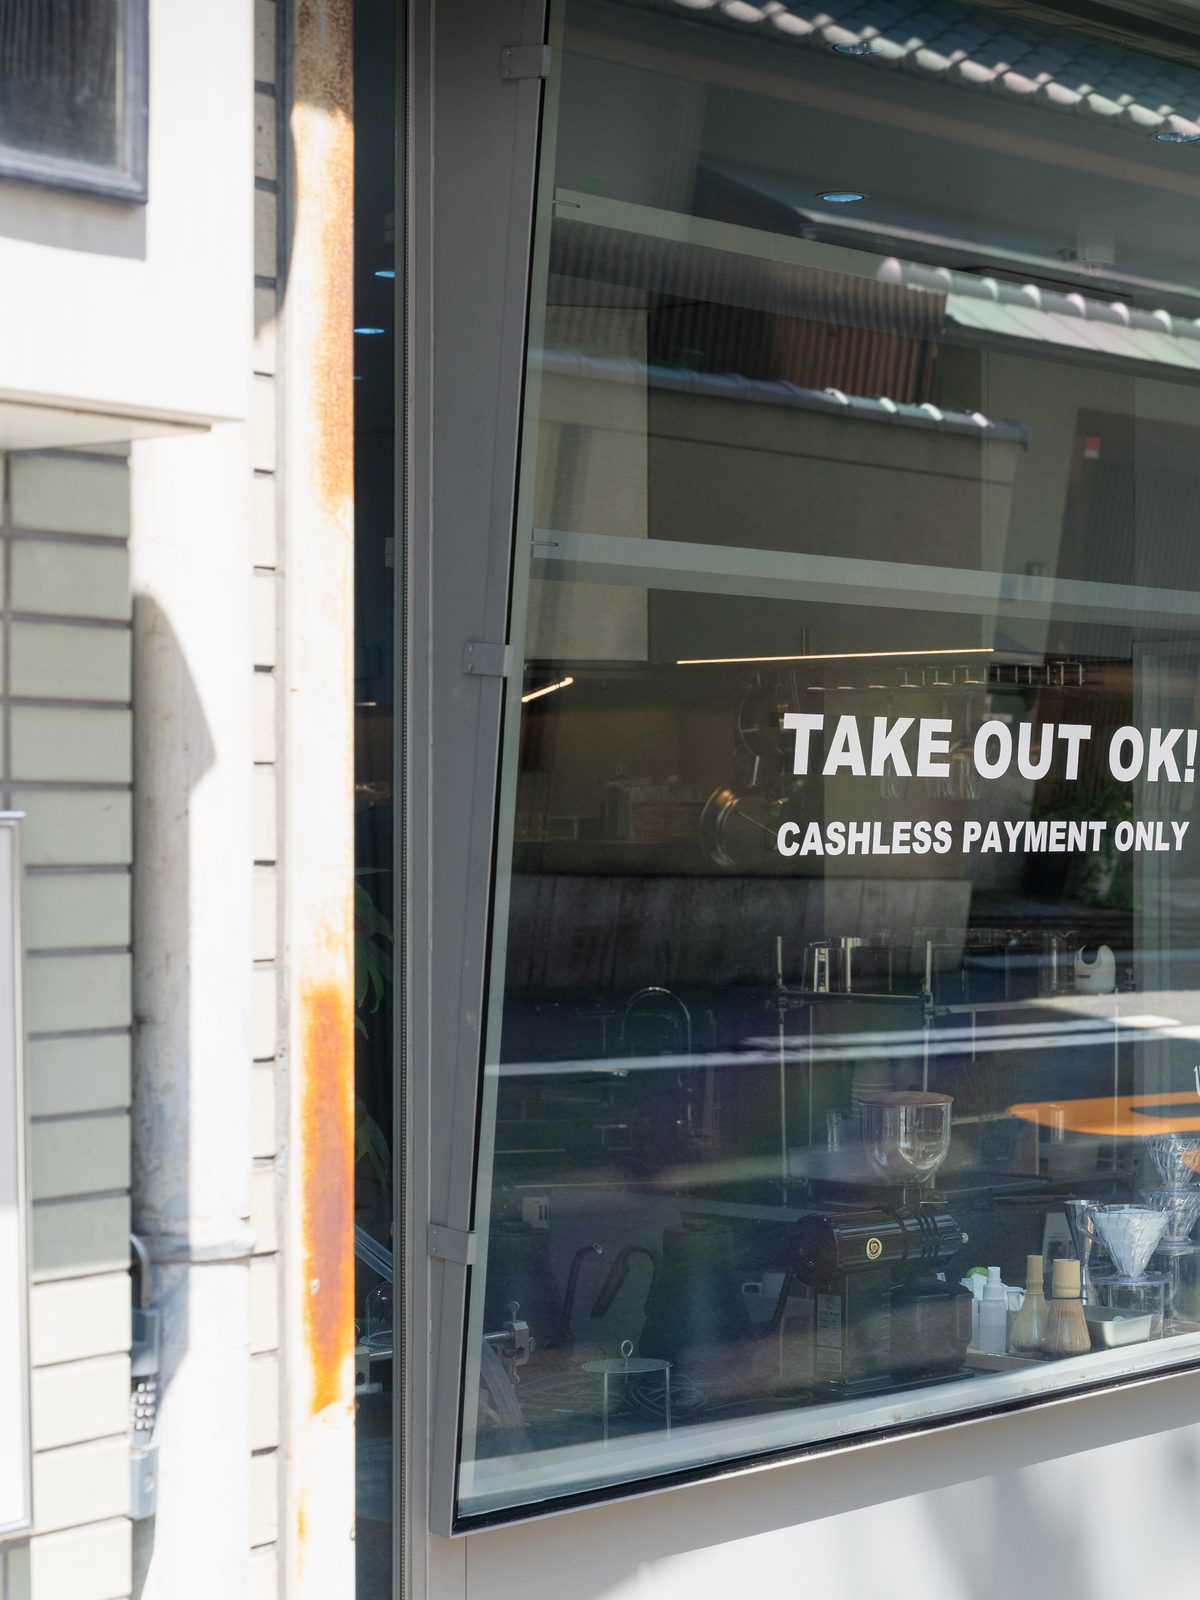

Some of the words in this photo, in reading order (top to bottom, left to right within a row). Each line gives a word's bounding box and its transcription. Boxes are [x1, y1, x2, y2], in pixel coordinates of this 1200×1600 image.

[783, 713, 953, 778] TAKE
[974, 720, 1092, 780] OUT
[1109, 726, 1198, 783] OK!
[778, 821, 953, 857] CASHLESS
[963, 821, 1107, 853] PAYMENT
[1115, 821, 1190, 851] ONLY
